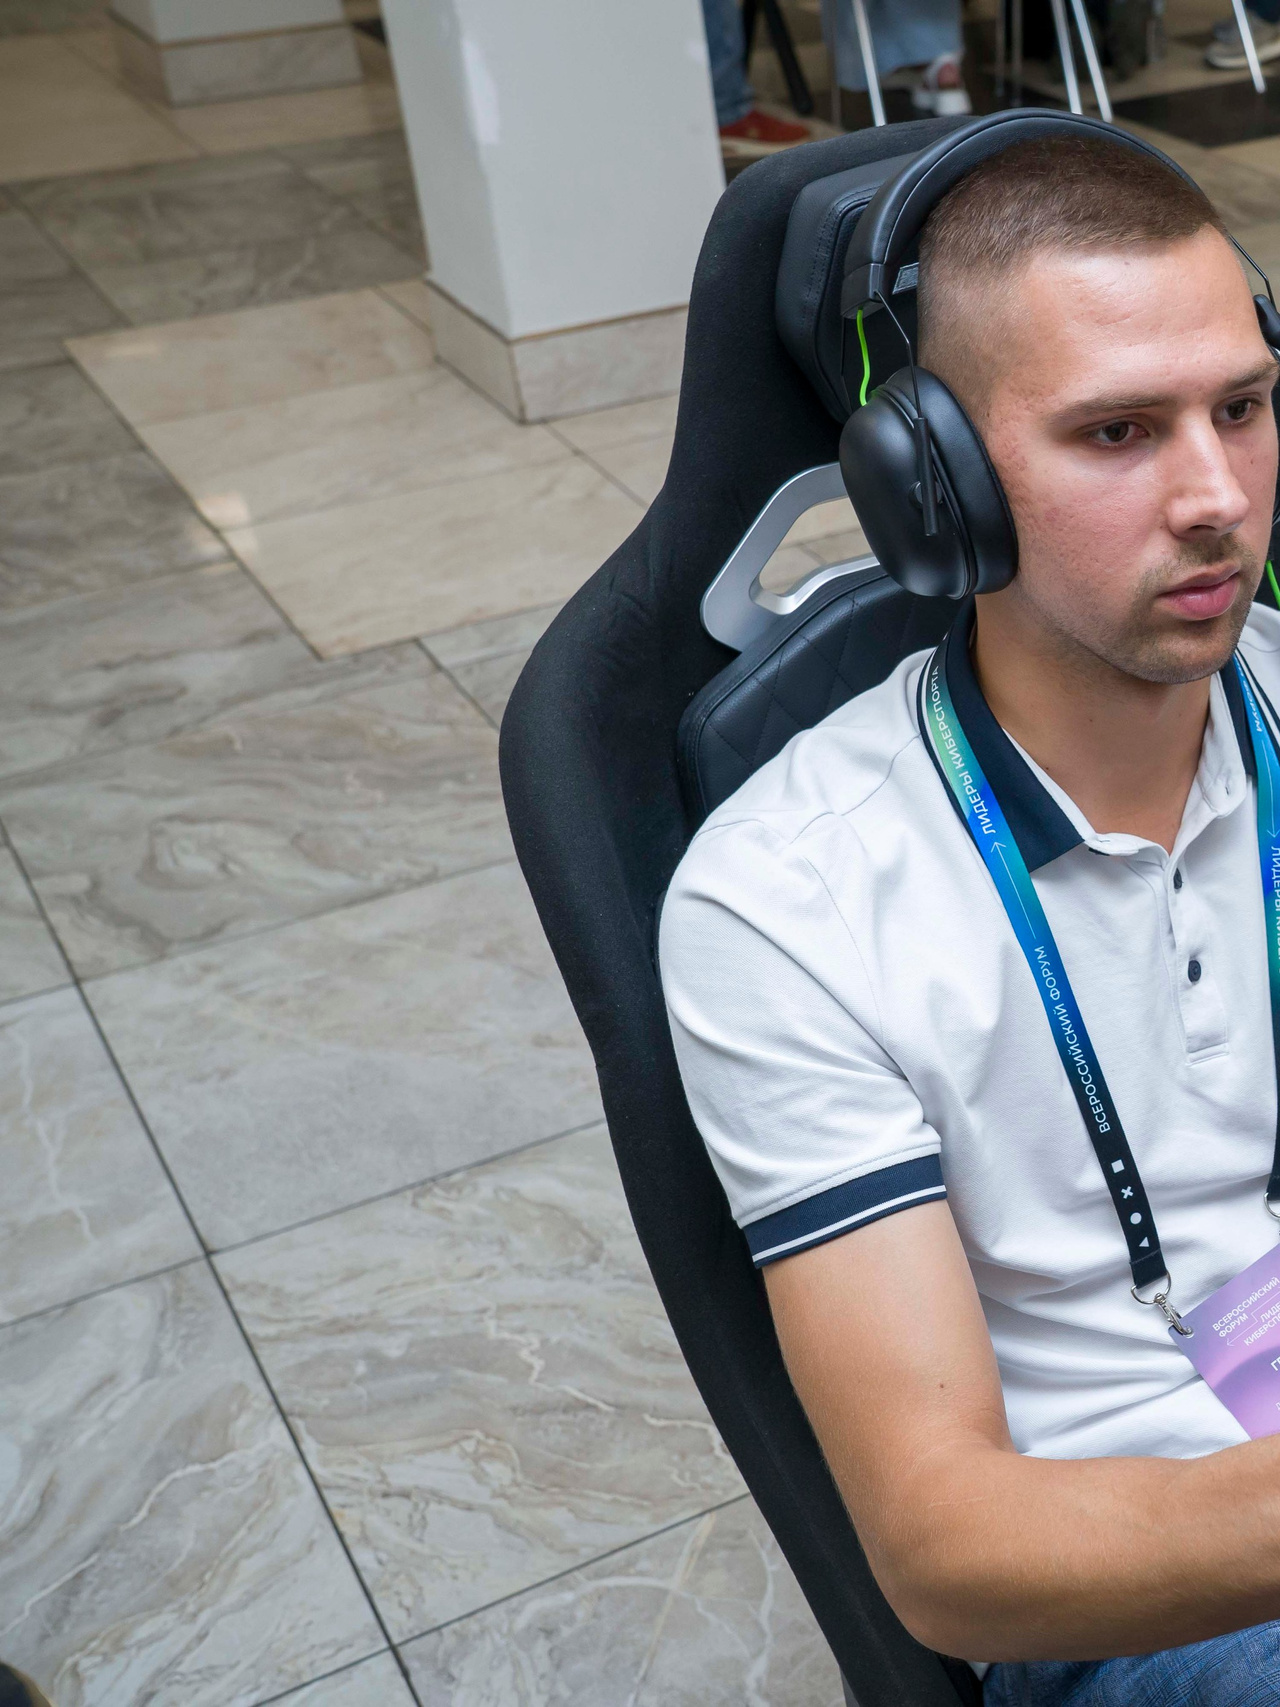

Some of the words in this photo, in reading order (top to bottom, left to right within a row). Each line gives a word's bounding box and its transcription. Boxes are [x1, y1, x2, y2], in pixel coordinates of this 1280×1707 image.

[931, 665, 966, 770] КИБЕРСПОРТА
[958, 770, 996, 835] ЛИДЕРЫ
[1033, 945, 1061, 1001] ФОРУМ
[1052, 1002, 1111, 1134] ВСЕРОССИЙСКИЙ
[1212, 1276, 1280, 1331] ВСЕРОССИЙСКИЙ
[1218, 1312, 1249, 1338] ФОРУМ
